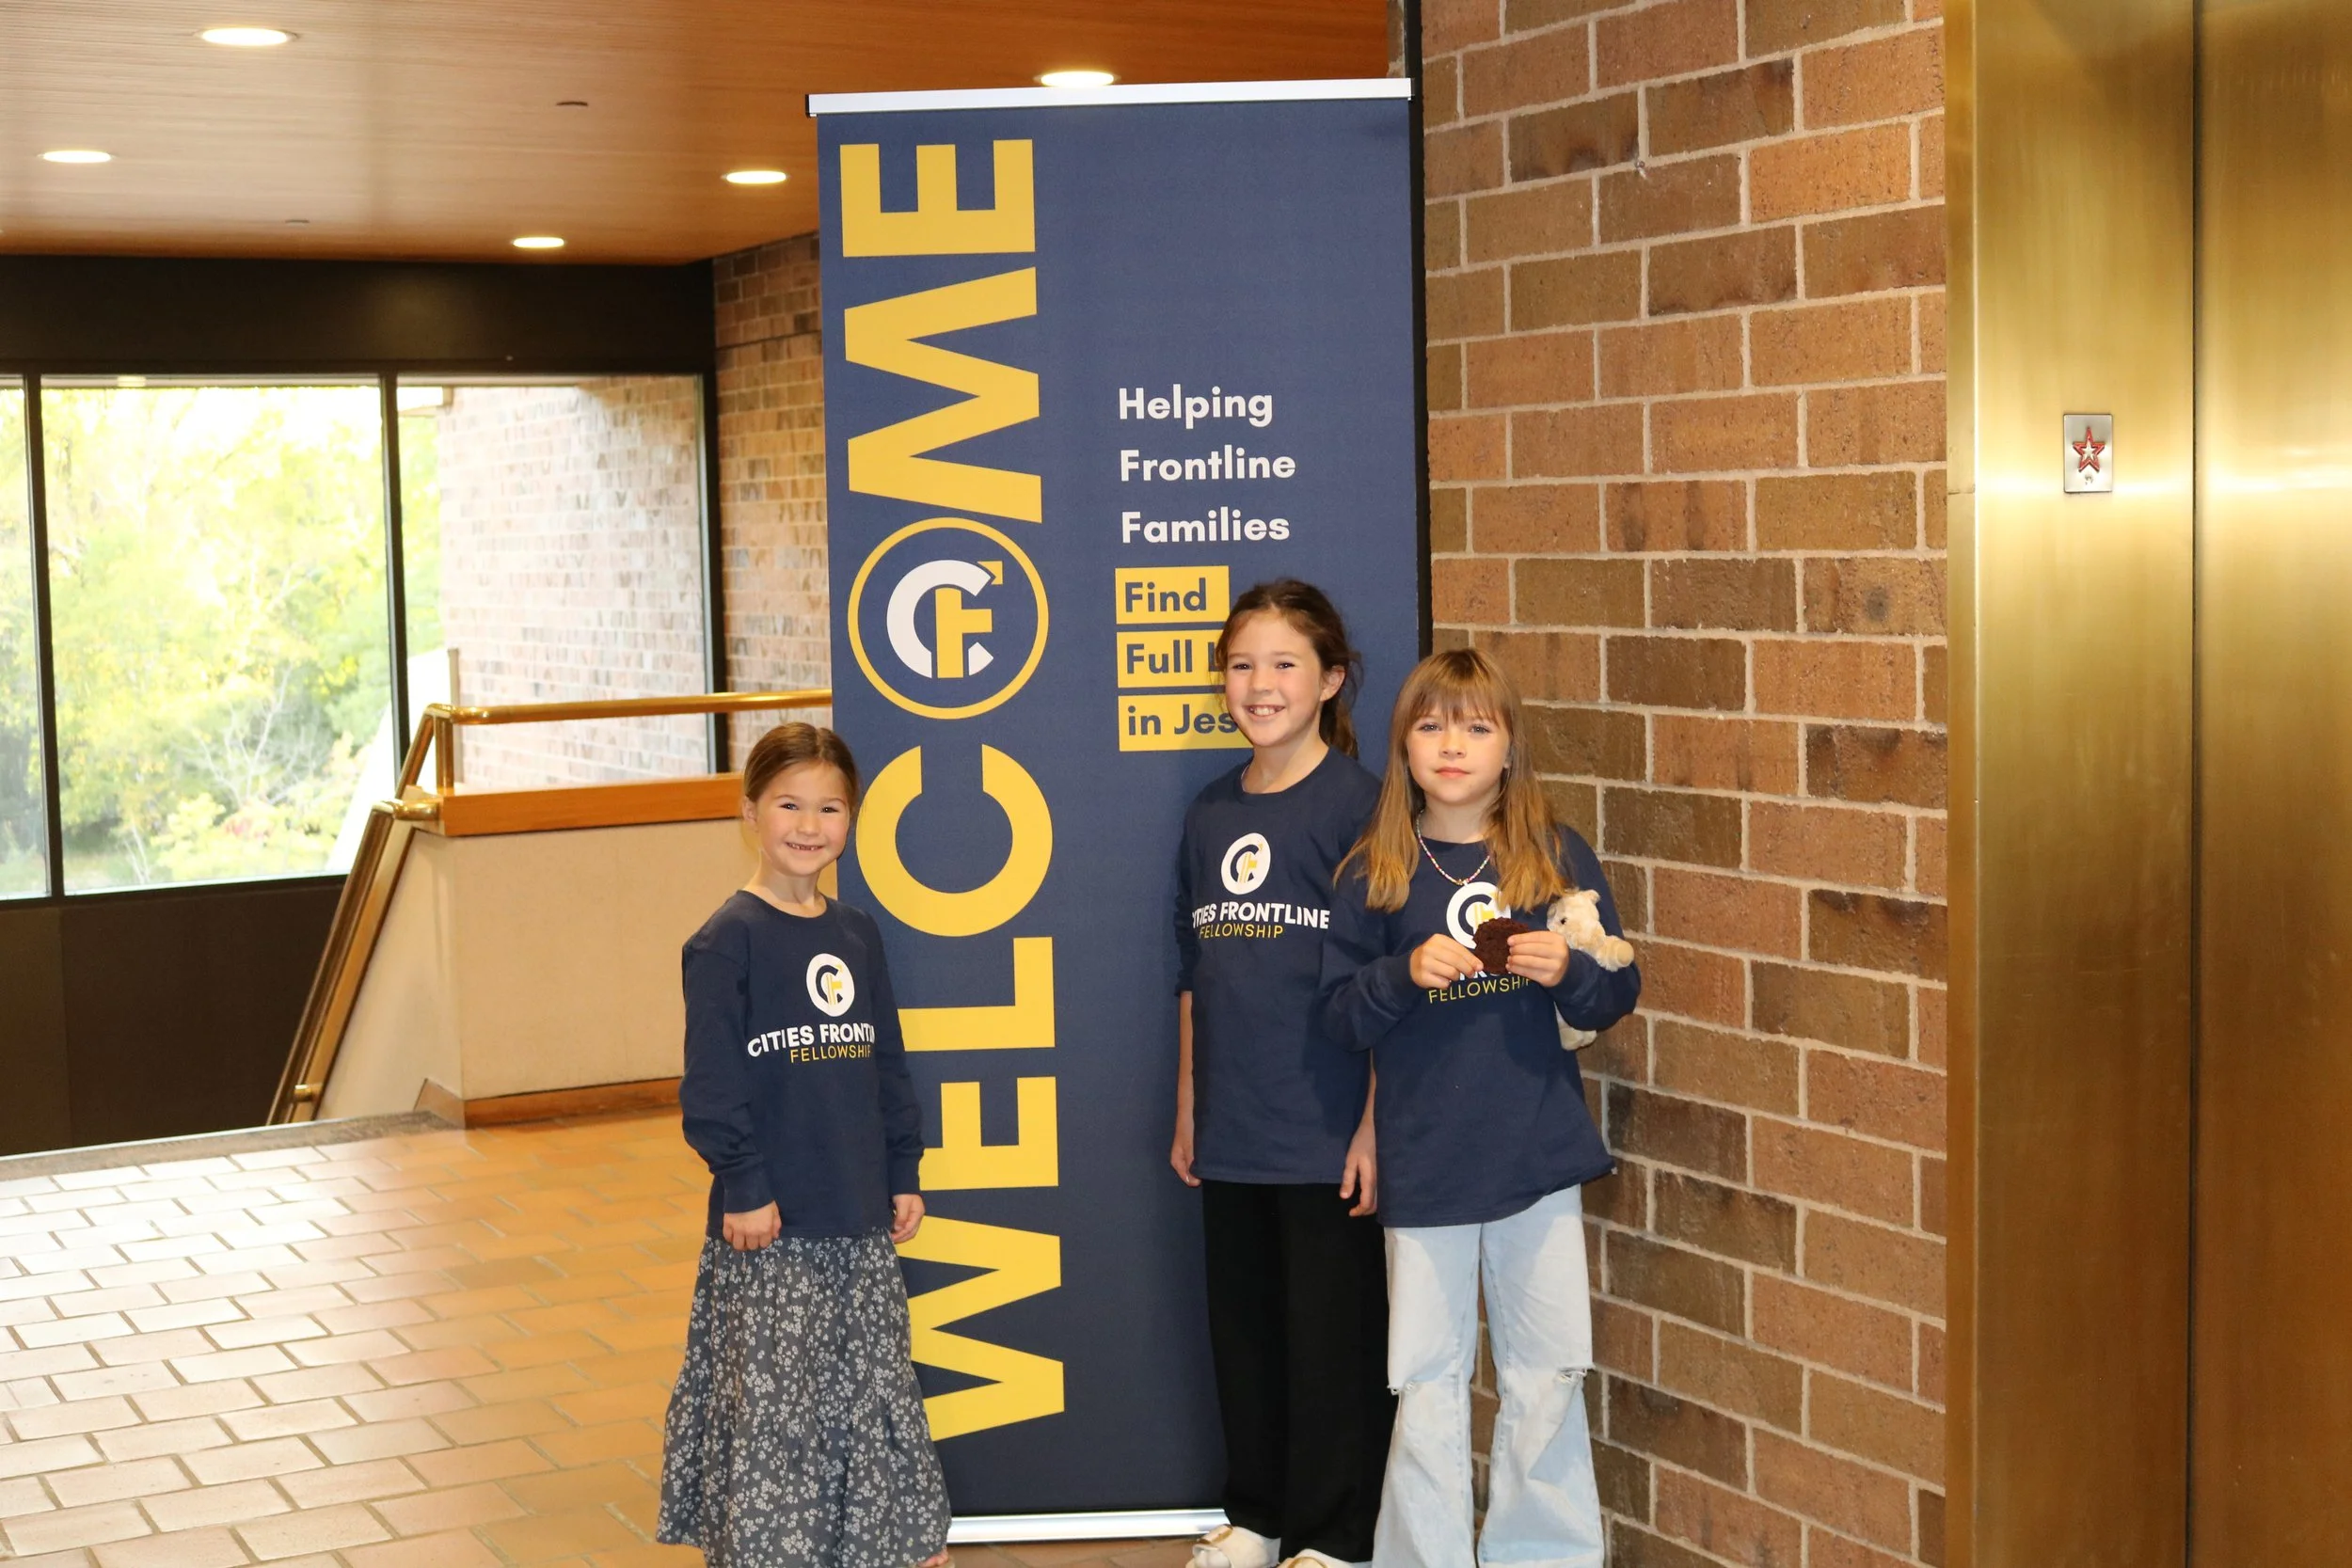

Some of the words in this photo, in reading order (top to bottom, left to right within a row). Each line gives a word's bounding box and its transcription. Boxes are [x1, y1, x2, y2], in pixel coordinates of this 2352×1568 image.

[1119, 384, 1273, 429] Helping
[1120, 444, 1296, 482] Frontline
[1122, 506, 1290, 544] Families
[1124, 578, 1207, 612] Find
[1127, 640, 1192, 673] Full
[1128, 705, 1161, 736] in
[1174, 705, 1238, 735] Jes
[1191, 903, 1217, 929] ITIES
[1219, 901, 1331, 929] FRONTLINE
[1199, 923, 1283, 940] FELLOWSHIP
[747, 1024, 815, 1057] CITIES
